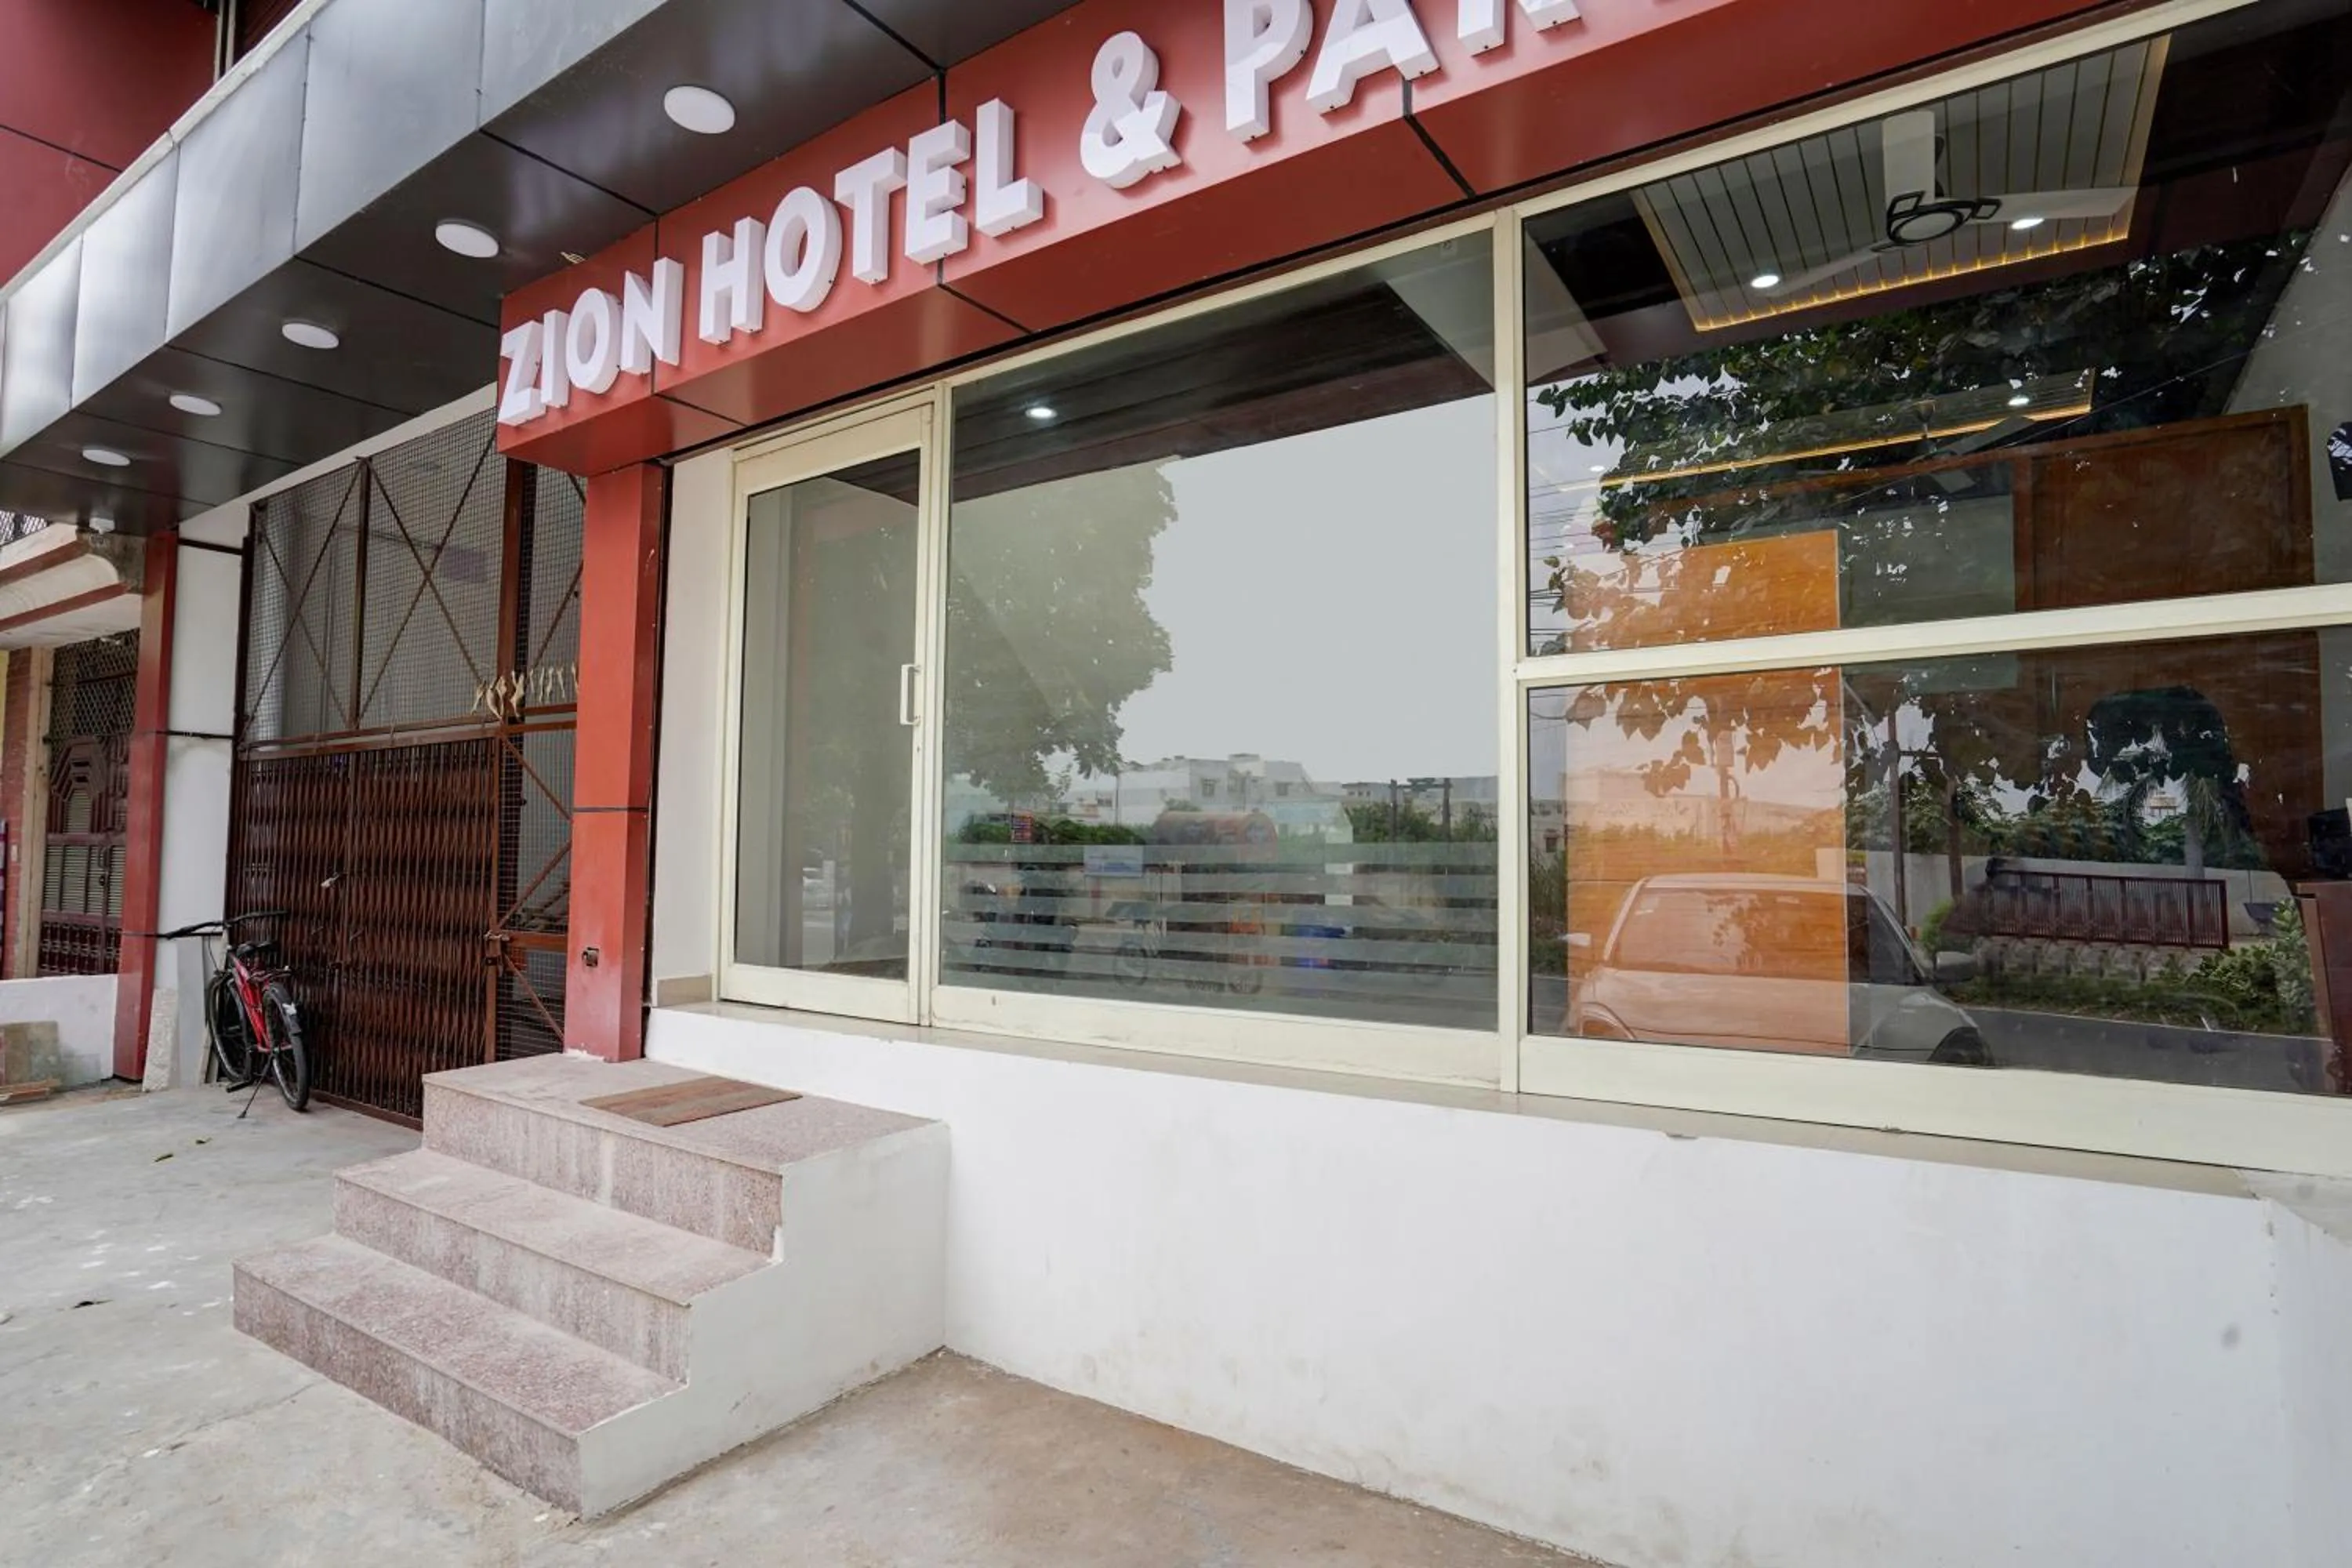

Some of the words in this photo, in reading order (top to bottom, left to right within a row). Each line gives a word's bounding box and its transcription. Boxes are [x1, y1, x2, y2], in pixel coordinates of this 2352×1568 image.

[496, 256, 684, 426] ZION
[699, 97, 1044, 346] HOTEL
[1080, 31, 1181, 190] &
[1224, 0, 1582, 144] PA
